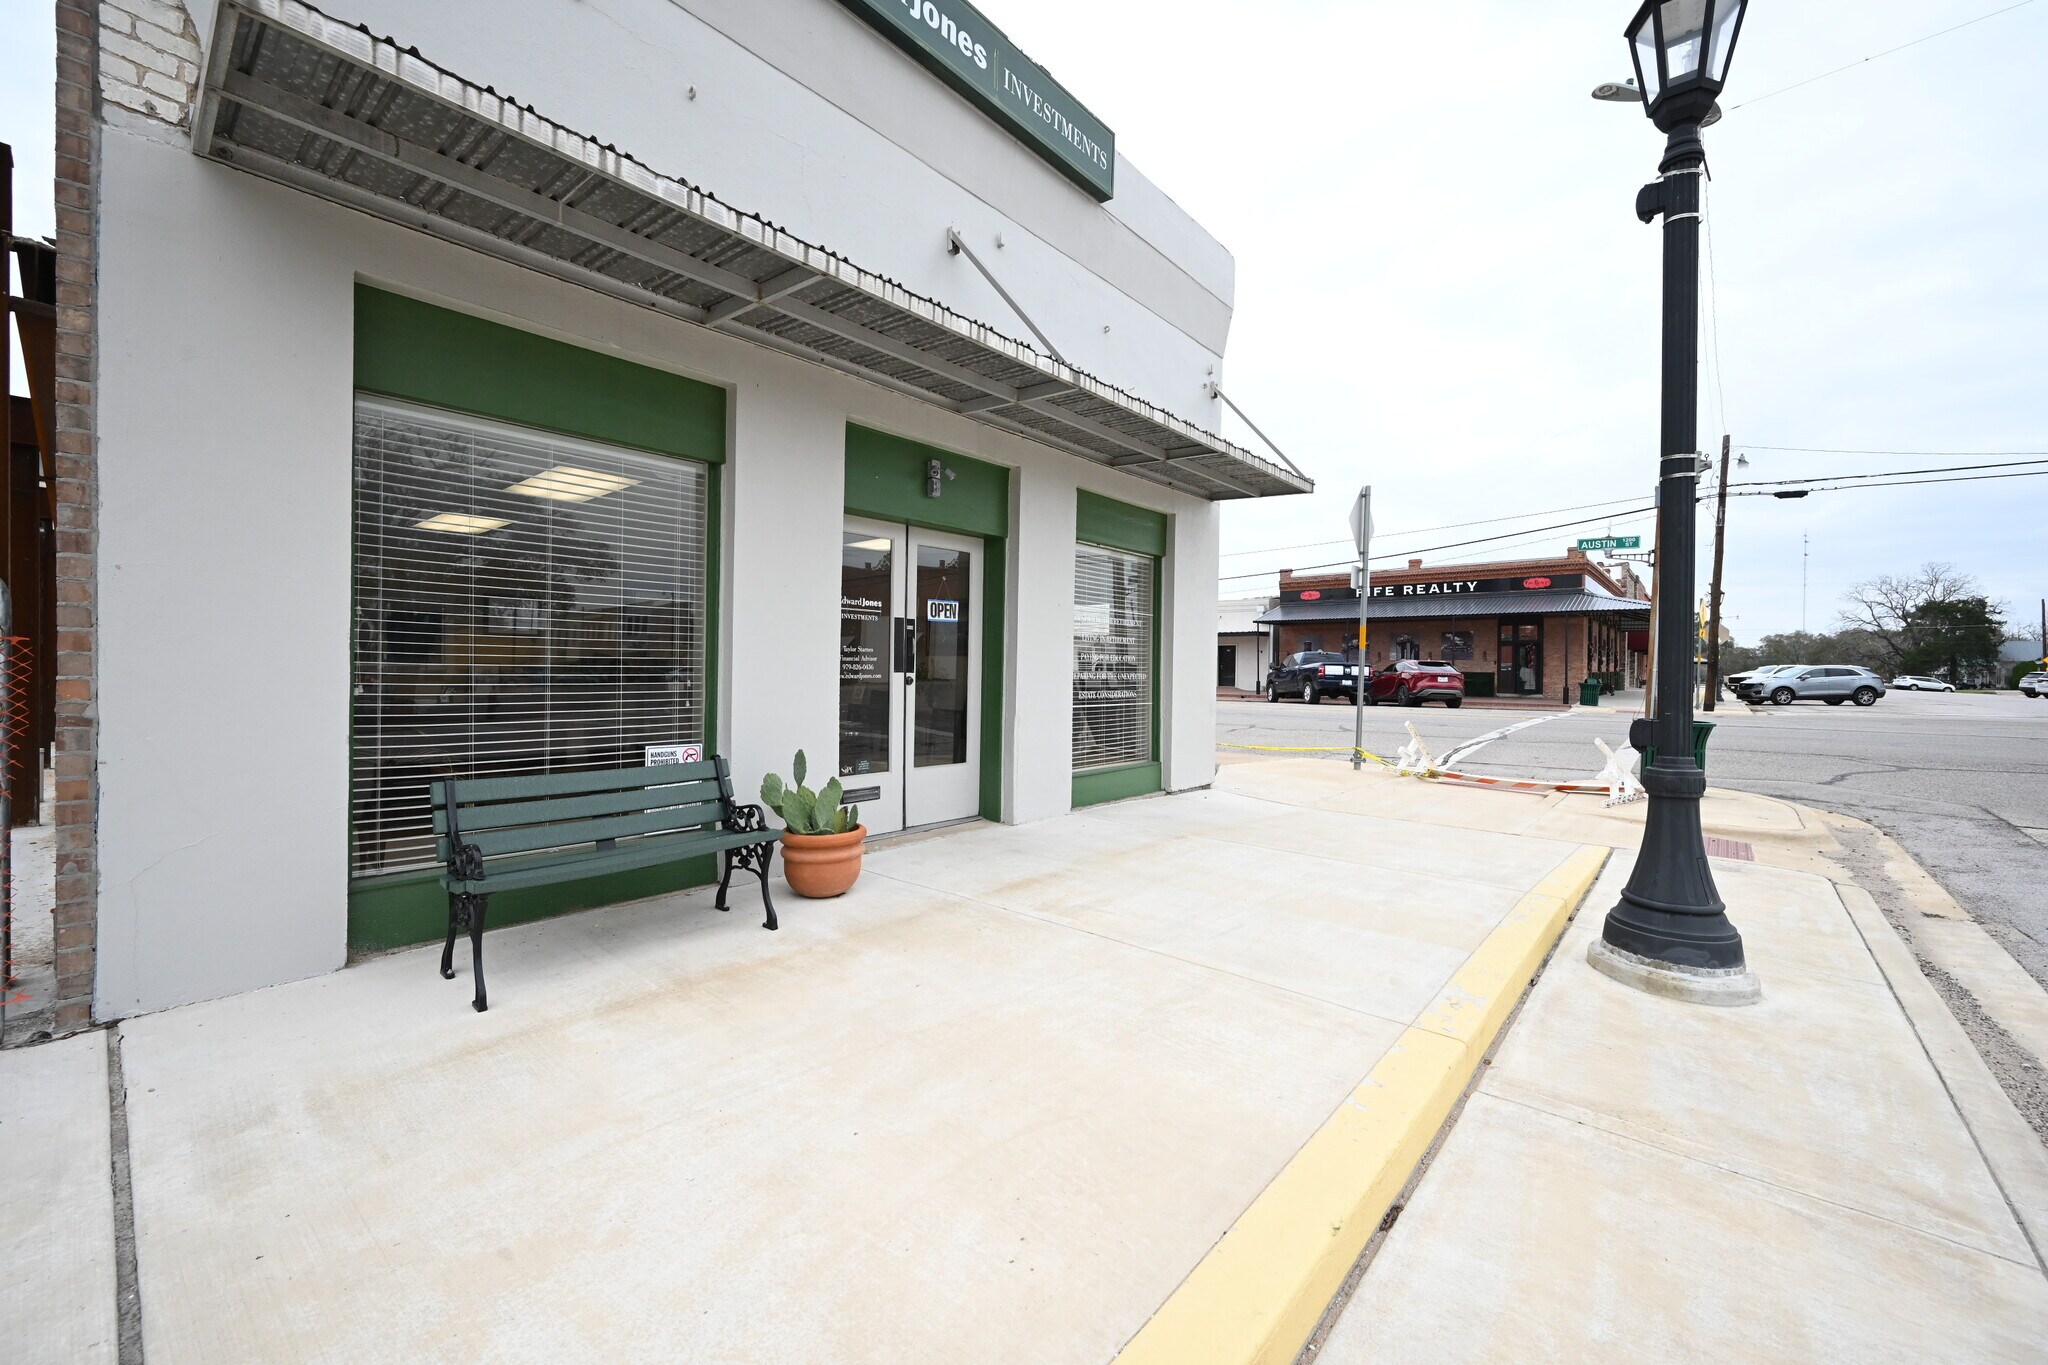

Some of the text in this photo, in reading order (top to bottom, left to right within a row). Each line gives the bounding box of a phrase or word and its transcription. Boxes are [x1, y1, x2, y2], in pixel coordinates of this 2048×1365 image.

[1003, 67, 1107, 170] INVESTMENTS
[1581, 540, 1617, 549] AUSTIN
[1403, 581, 1478, 595] REALTY
[930, 602, 957, 619] OPEN
[841, 613, 879, 621] INVESTMENTS
[651, 751, 677, 759] HANDGUNS
[651, 758, 679, 766] PROHIBITED
